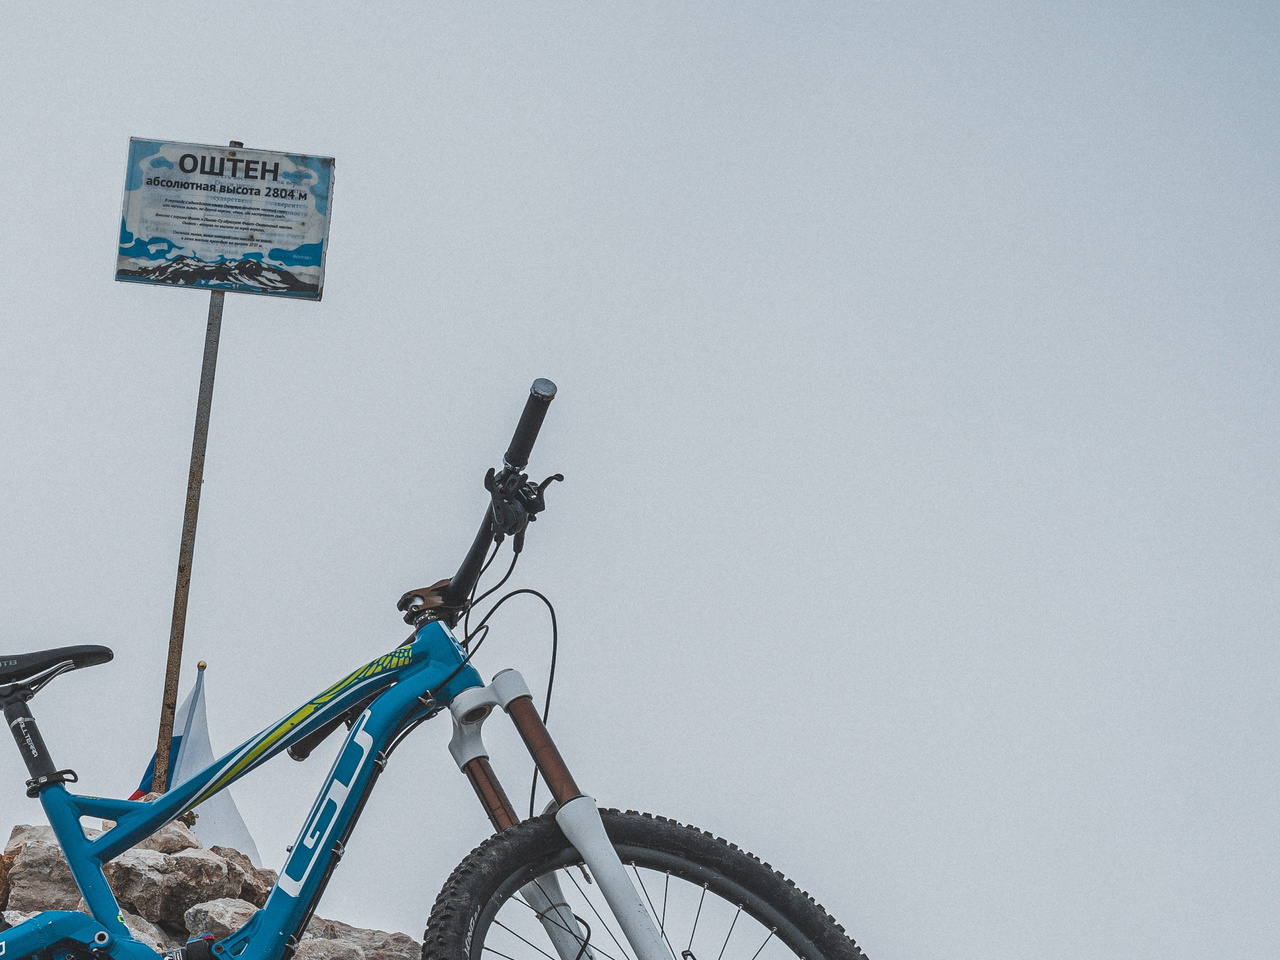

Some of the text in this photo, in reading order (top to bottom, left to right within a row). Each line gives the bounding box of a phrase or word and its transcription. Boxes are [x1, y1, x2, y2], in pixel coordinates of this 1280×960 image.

[178, 153, 280, 182] ОШТЕН
[146, 176, 216, 193] абсолютная
[219, 184, 261, 197] высота
[264, 186, 295, 200] 2804
[298, 192, 308, 201] м
[278, 709, 374, 898] GT
